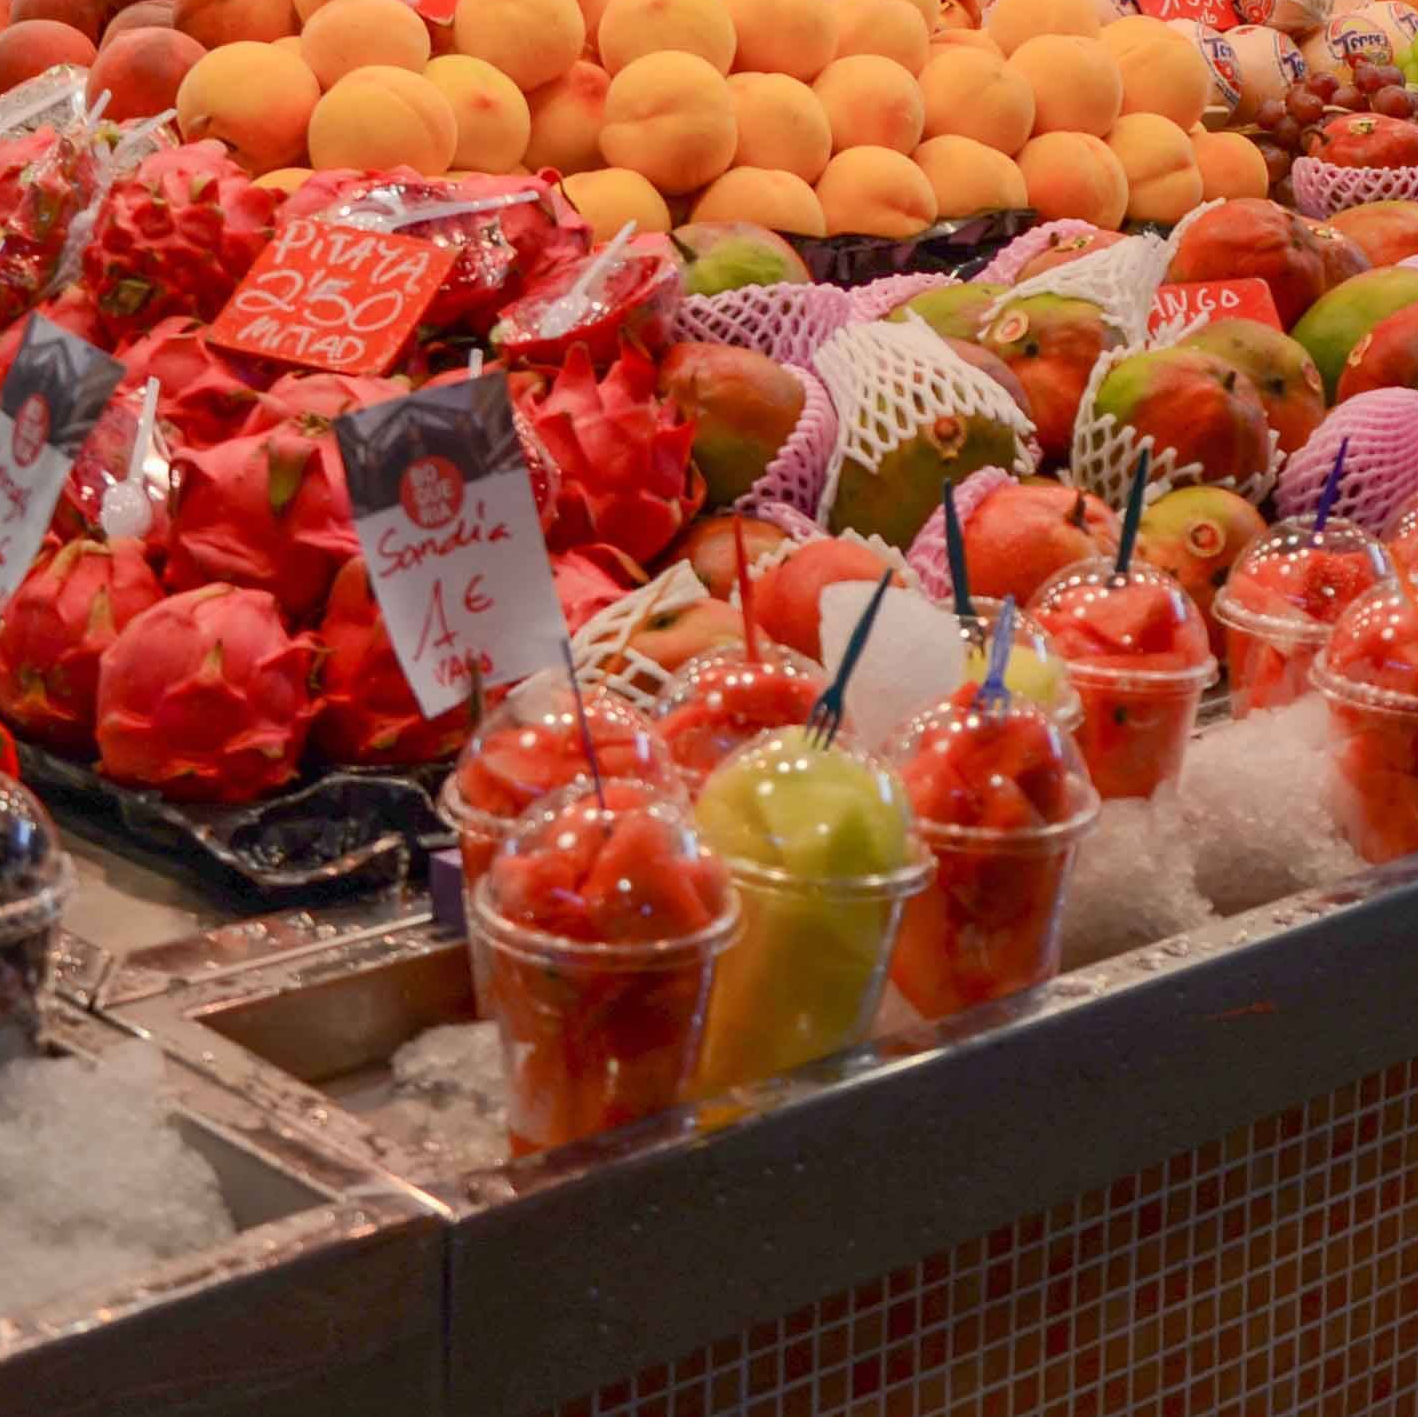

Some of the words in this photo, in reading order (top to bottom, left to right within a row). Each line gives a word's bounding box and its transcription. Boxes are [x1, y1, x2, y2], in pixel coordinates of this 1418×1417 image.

[274, 219, 432, 294] PITAYA
[235, 268, 403, 332] 2'50
[1149, 286, 1240, 320] ANGO
